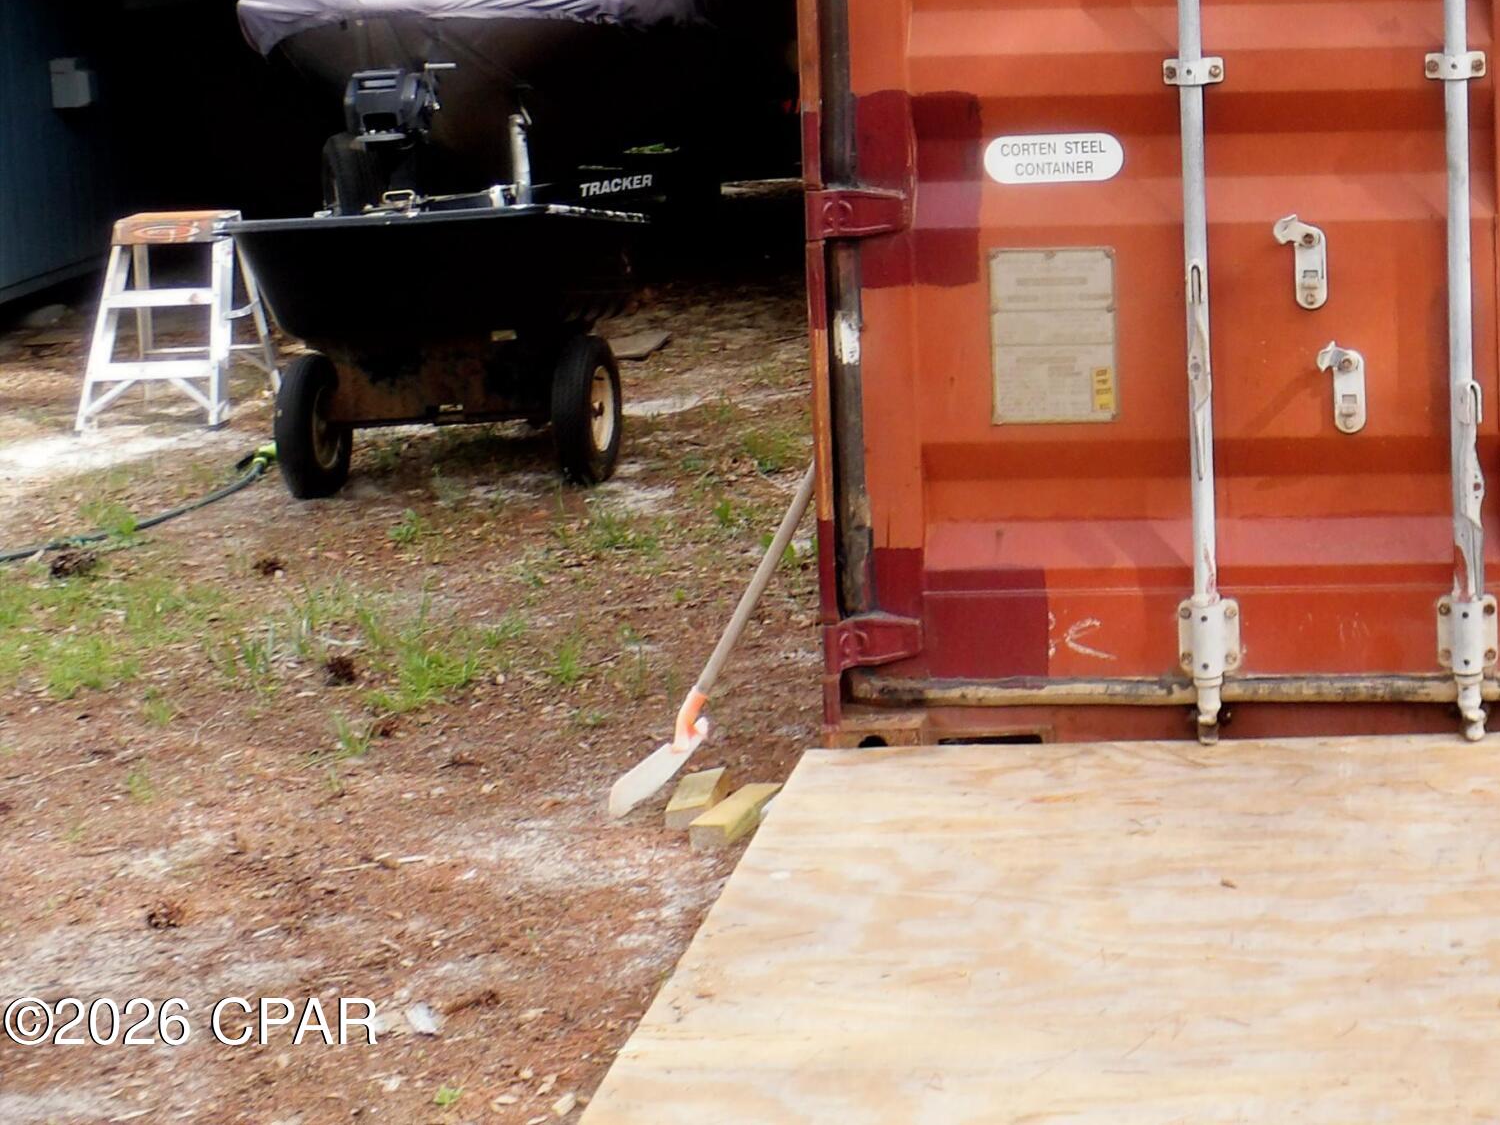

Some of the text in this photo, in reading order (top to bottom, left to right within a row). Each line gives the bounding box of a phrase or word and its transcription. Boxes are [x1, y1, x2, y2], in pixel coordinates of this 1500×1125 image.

[1000, 140, 1107, 157] CORTEN STEEL
[1015, 161, 1094, 177] CONTAINER
[580, 174, 653, 197] TRACKER
